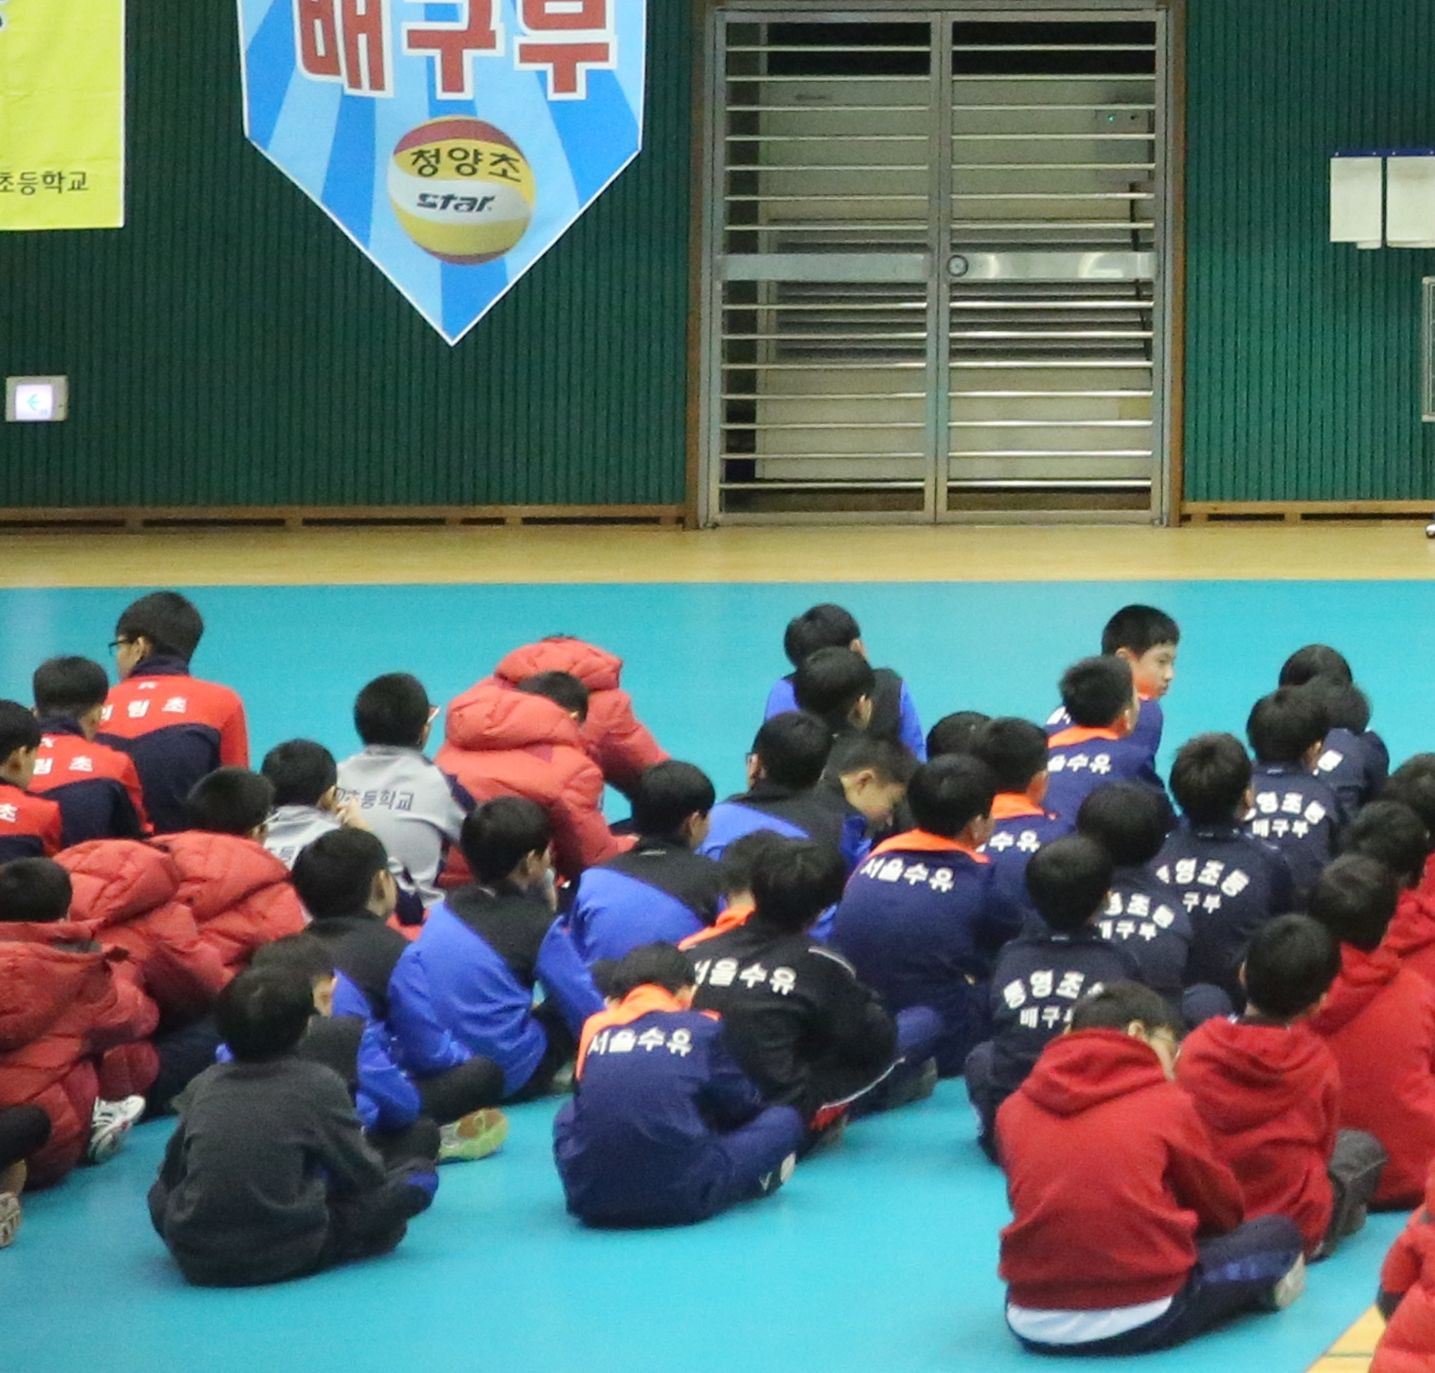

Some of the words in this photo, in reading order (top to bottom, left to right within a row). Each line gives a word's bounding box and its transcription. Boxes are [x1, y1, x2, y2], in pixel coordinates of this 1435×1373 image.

[409, 144, 521, 182] 청양초
[973, 829, 1042, 854] 수유
[859, 857, 955, 894] 서울수유
[587, 1025, 694, 1058] 서울수유
